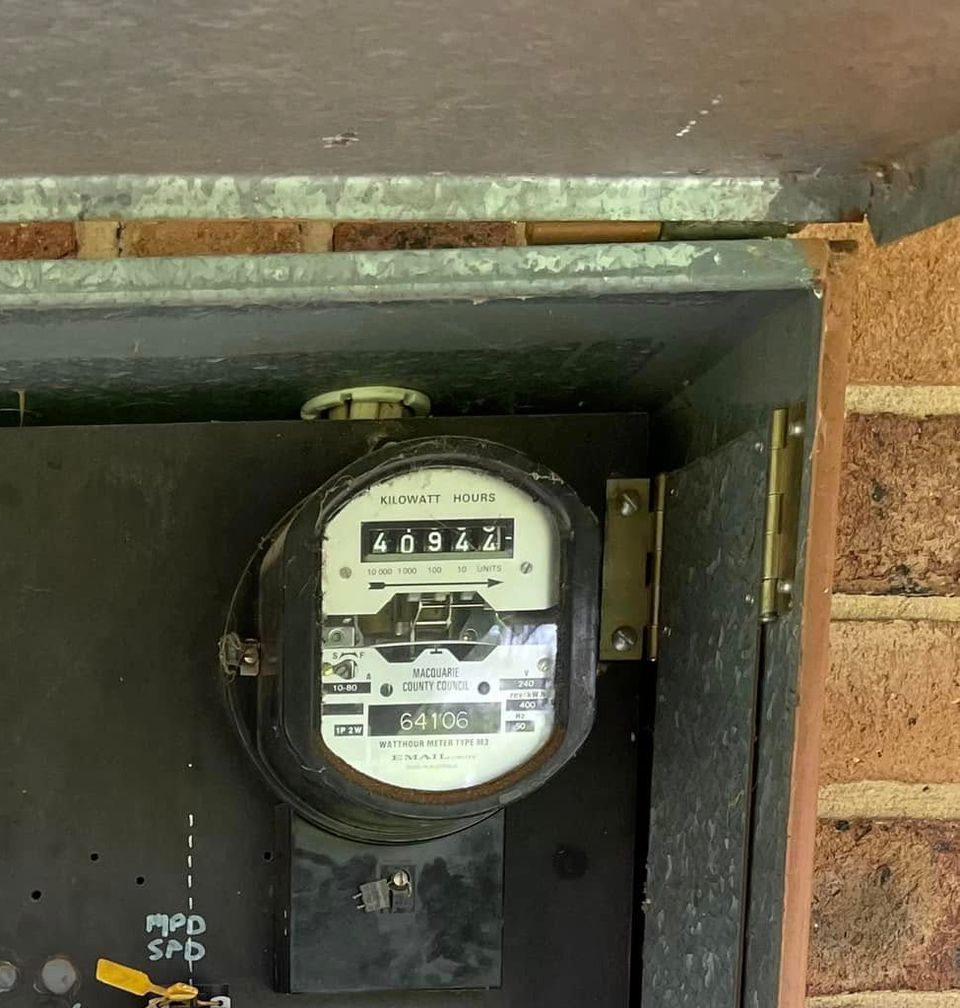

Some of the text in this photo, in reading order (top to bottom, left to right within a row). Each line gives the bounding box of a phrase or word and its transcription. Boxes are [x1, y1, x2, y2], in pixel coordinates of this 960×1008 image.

[380, 492, 496, 505] KILOWATT HOURS
[428, 566, 442, 574] 100
[332, 652, 339, 660] S
[366, 672, 372, 680] A
[412, 667, 460, 678] MACQUARIE
[333, 684, 358, 692] 10-80
[402, 680, 470, 692] COUNTY COUNCIL
[519, 701, 536, 709] 400
[400, 711, 469, 730] 64106
[348, 726, 362, 735] 2W
[379, 740, 425, 749] WATTHOUR
[426, 739, 454, 748] METER
[455, 738, 474, 747] TYPE
[391, 753, 448, 761] EMAIL
[146, 912, 207, 938] MPD
[147, 938, 206, 962] SPD
